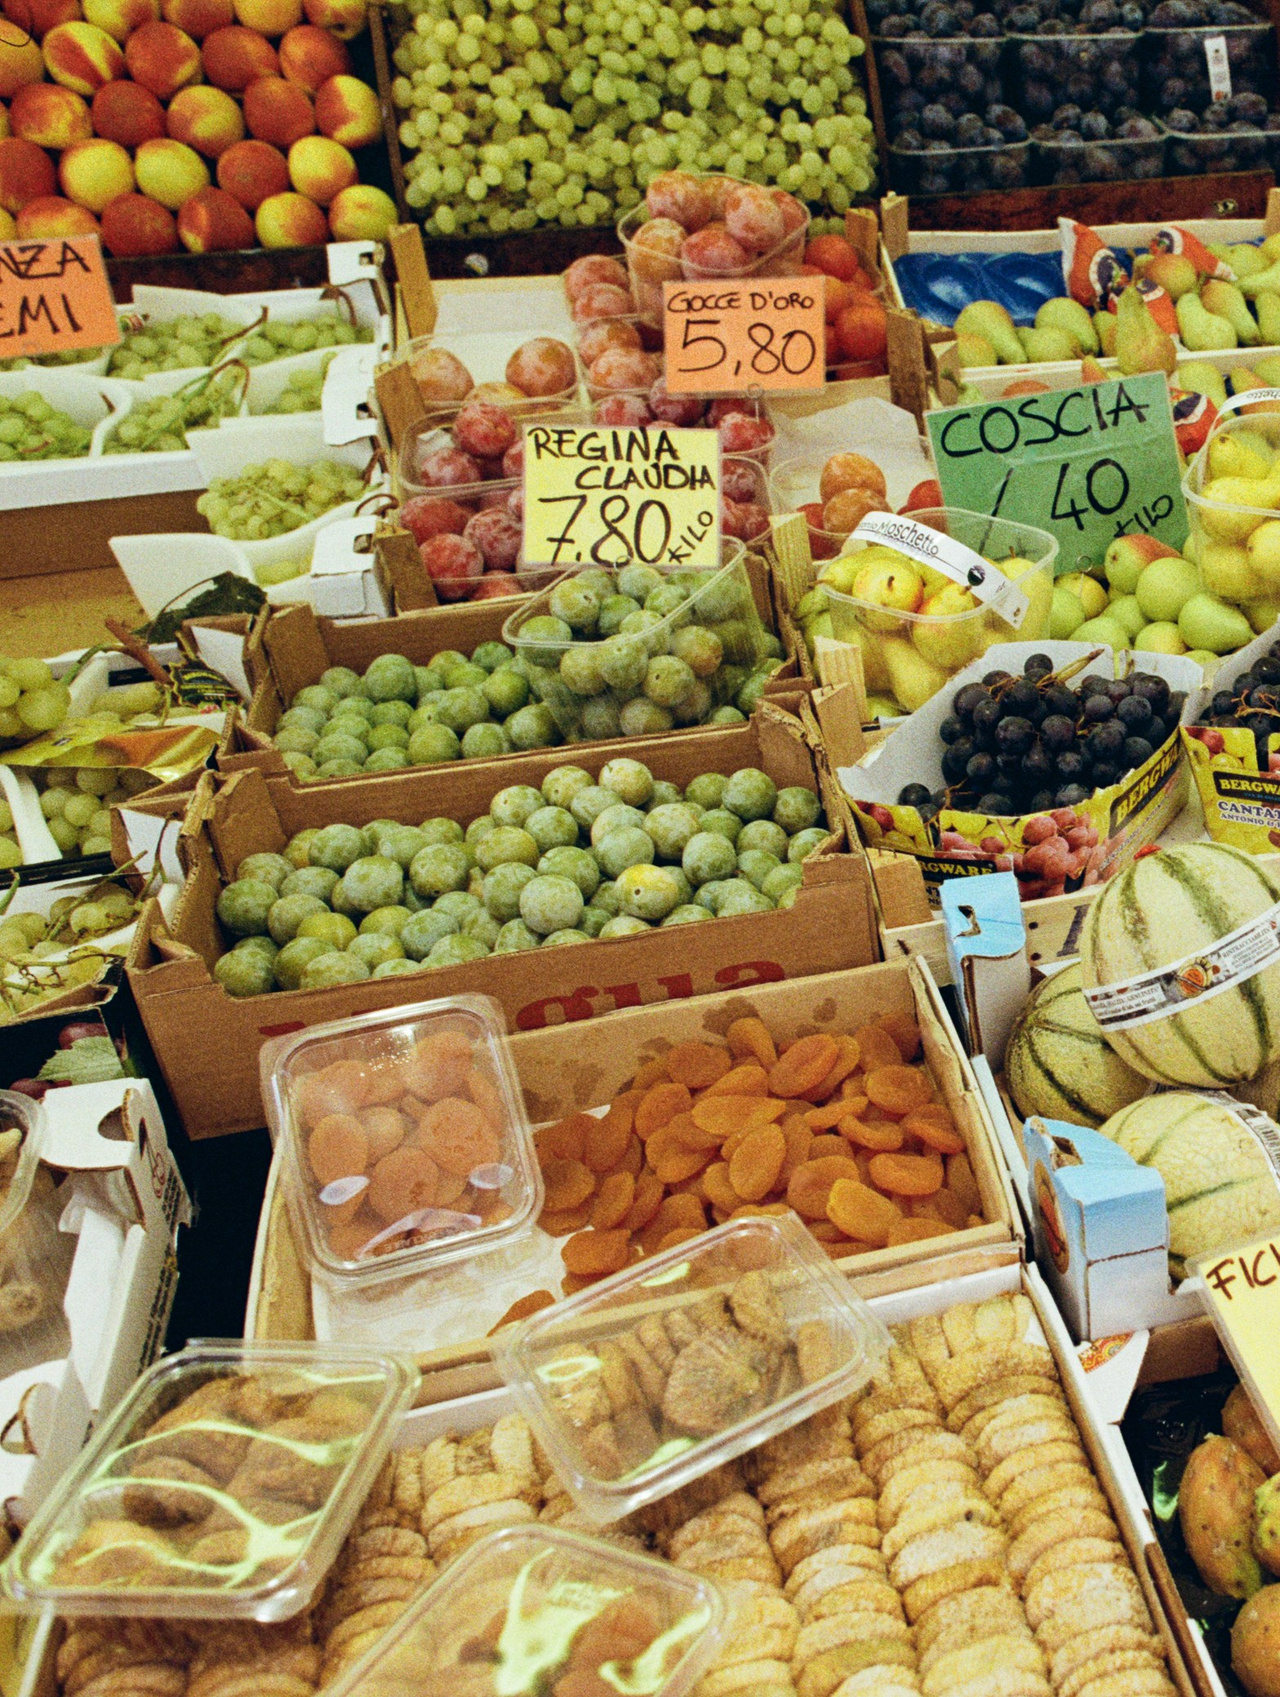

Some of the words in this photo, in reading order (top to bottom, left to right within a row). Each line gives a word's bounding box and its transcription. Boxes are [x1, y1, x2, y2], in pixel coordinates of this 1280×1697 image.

[667, 291, 741, 313] GOCCE
[749, 291, 814, 311] D'ORO
[941, 382, 1150, 458] COSCIA
[527, 425, 681, 463] REGINA
[574, 463, 716, 491] CLAUDIA
[667, 510, 714, 565] KILO
[876, 520, 939, 557] Moschetto
[1221, 812, 1265, 826] ANTONIO
